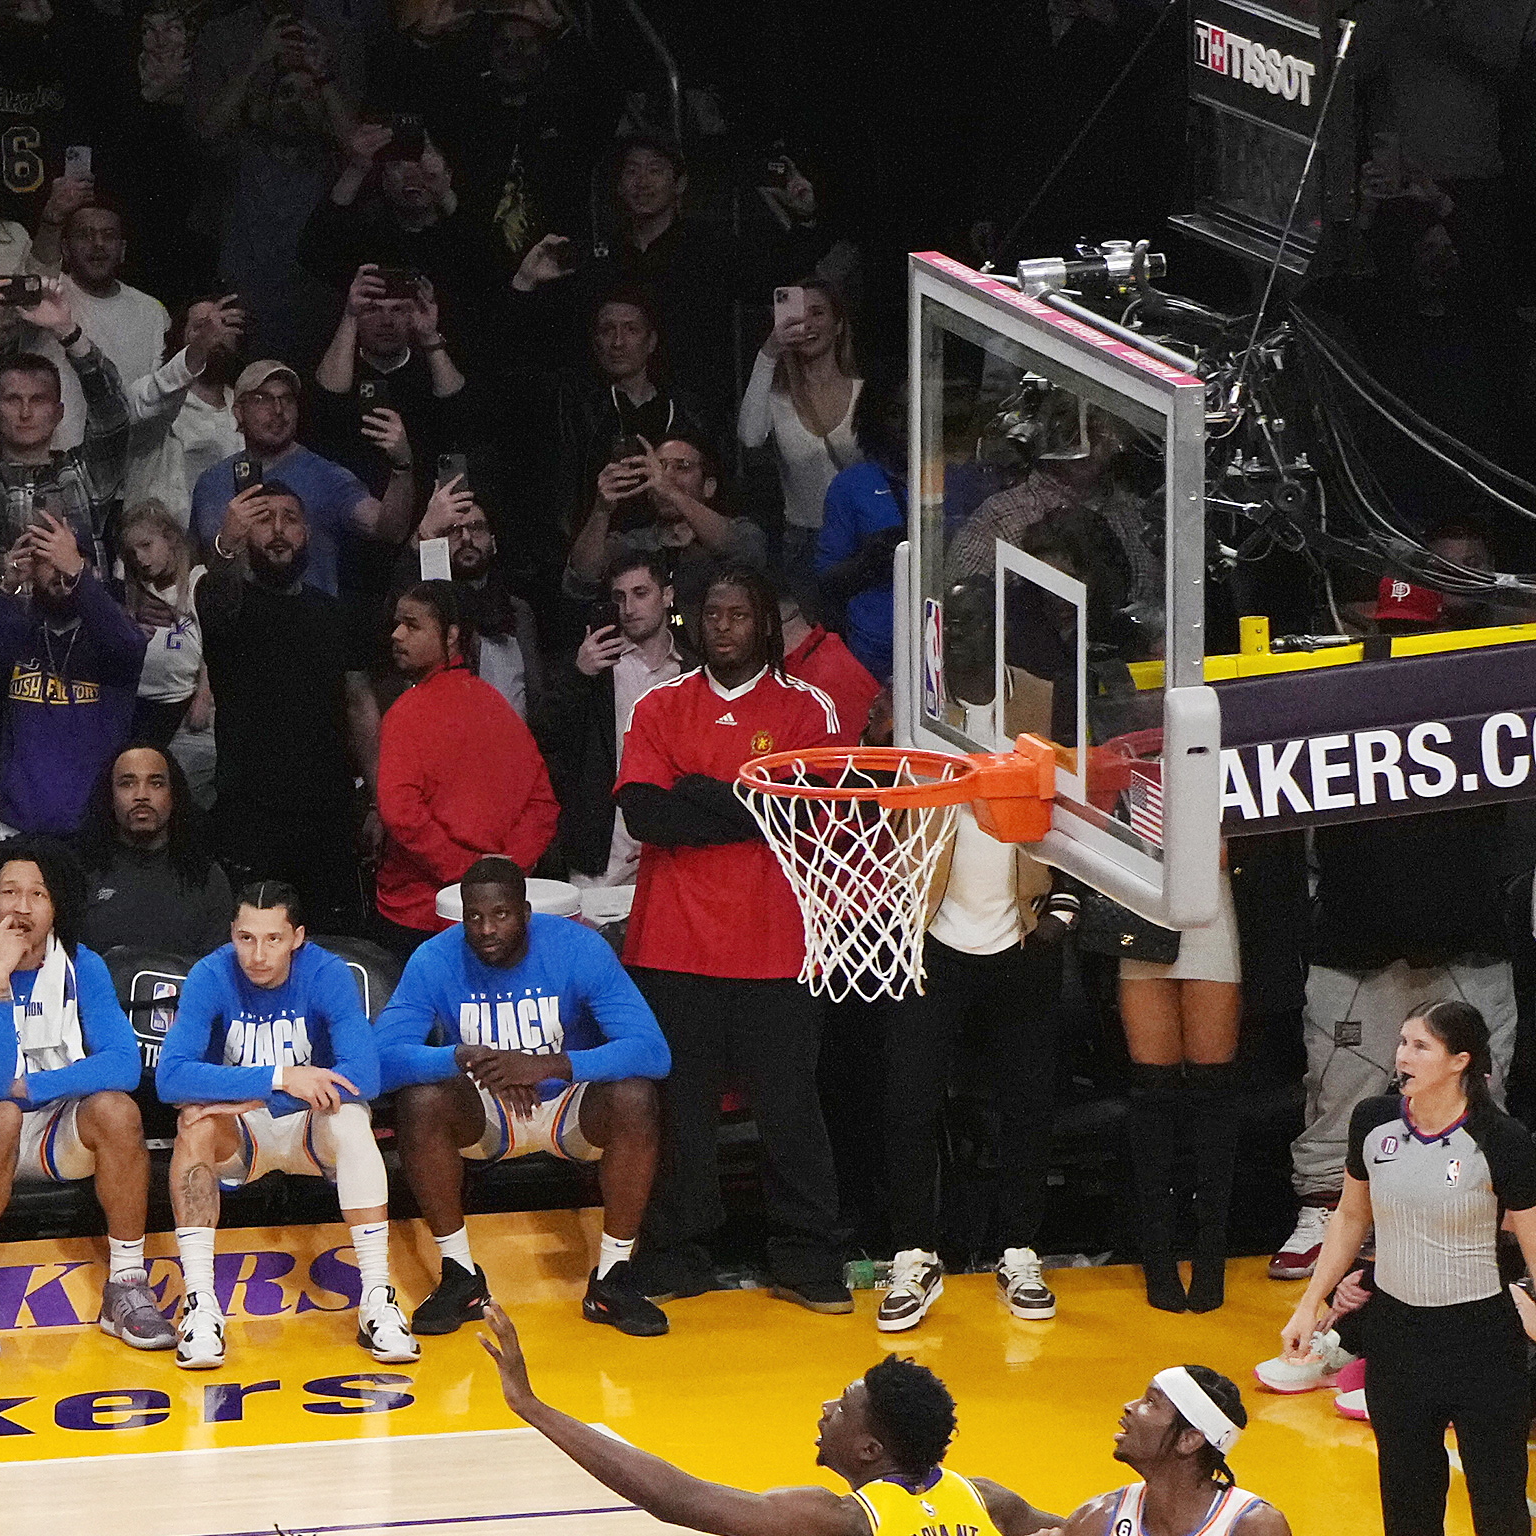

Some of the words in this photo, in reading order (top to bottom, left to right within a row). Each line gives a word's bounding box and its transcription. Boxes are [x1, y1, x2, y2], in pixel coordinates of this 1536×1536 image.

[1225, 33, 1316, 107] TISSOT
[1, 127, 46, 193] 6
[1219, 711, 1536, 823] AKERS.C
[223, 1017, 313, 1067] BLACK
[459, 994, 562, 1051] BLACK
